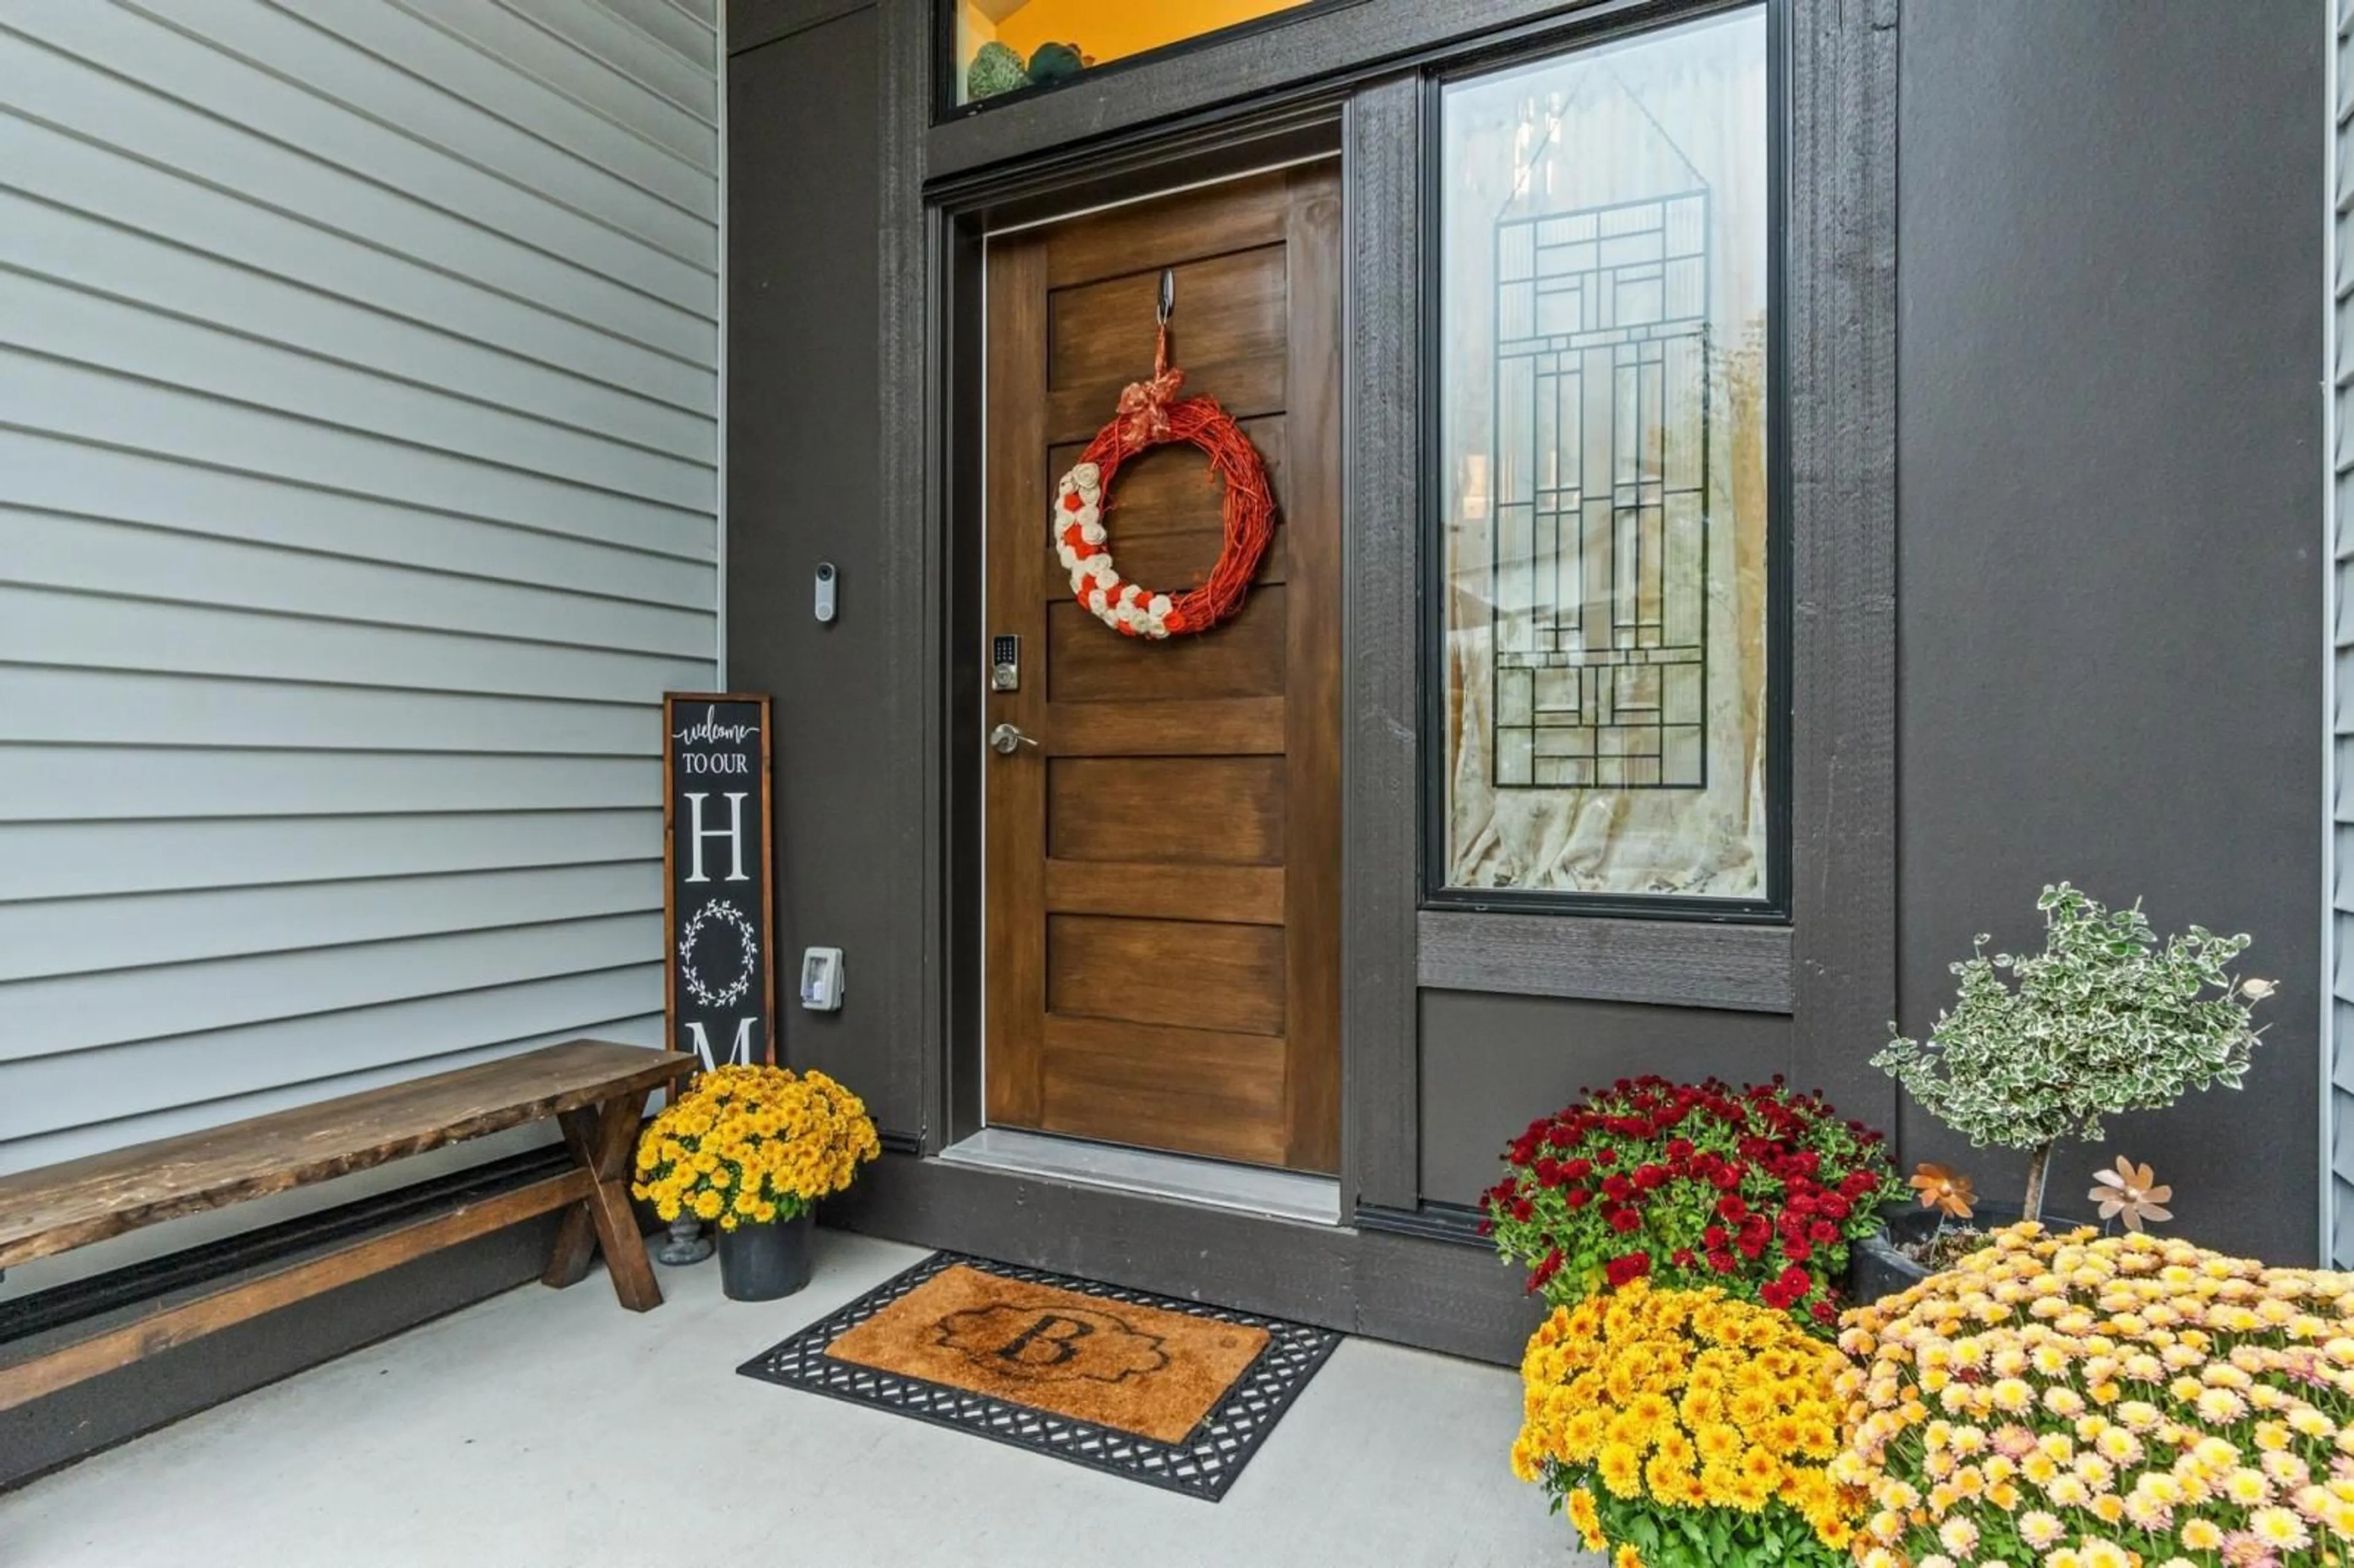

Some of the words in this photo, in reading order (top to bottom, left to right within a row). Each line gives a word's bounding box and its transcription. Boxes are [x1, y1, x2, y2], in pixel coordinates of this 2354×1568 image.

[672, 704, 761, 745] welcome
[682, 753, 708, 774] TO
[710, 753, 748, 774] OUR
[997, 1315, 1095, 1364] B
